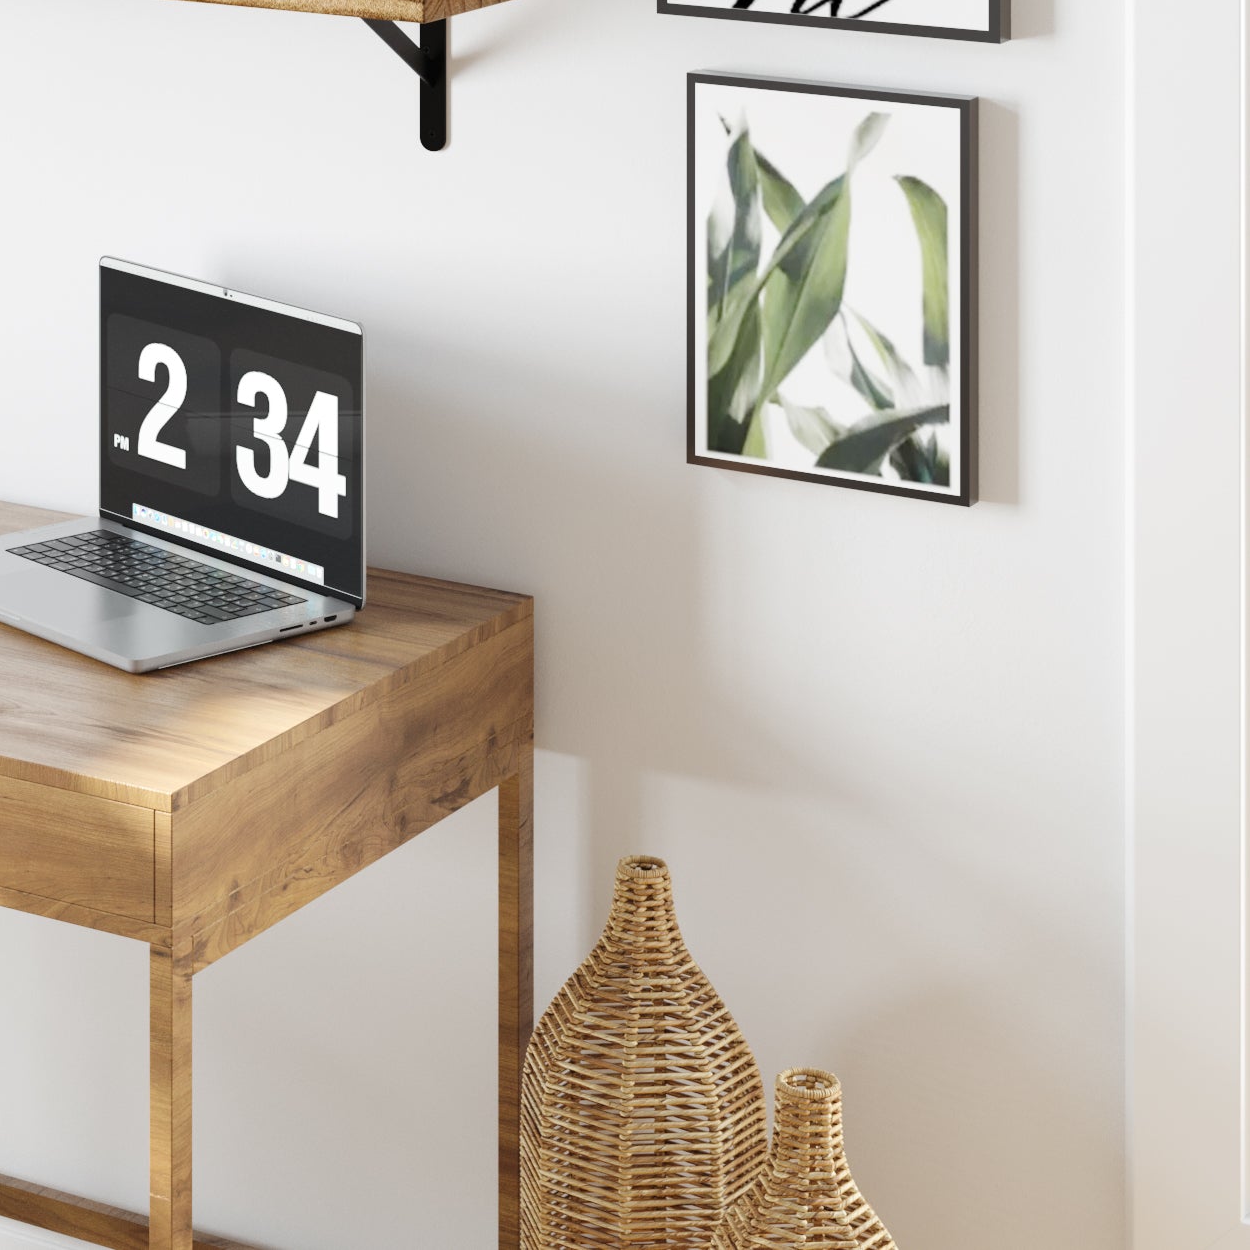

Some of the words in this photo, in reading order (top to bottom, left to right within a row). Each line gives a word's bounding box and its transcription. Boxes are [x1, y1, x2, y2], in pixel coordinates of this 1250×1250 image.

[113, 433, 129, 451] PM
[138, 342, 188, 470] 2
[236, 371, 346, 518] 34
